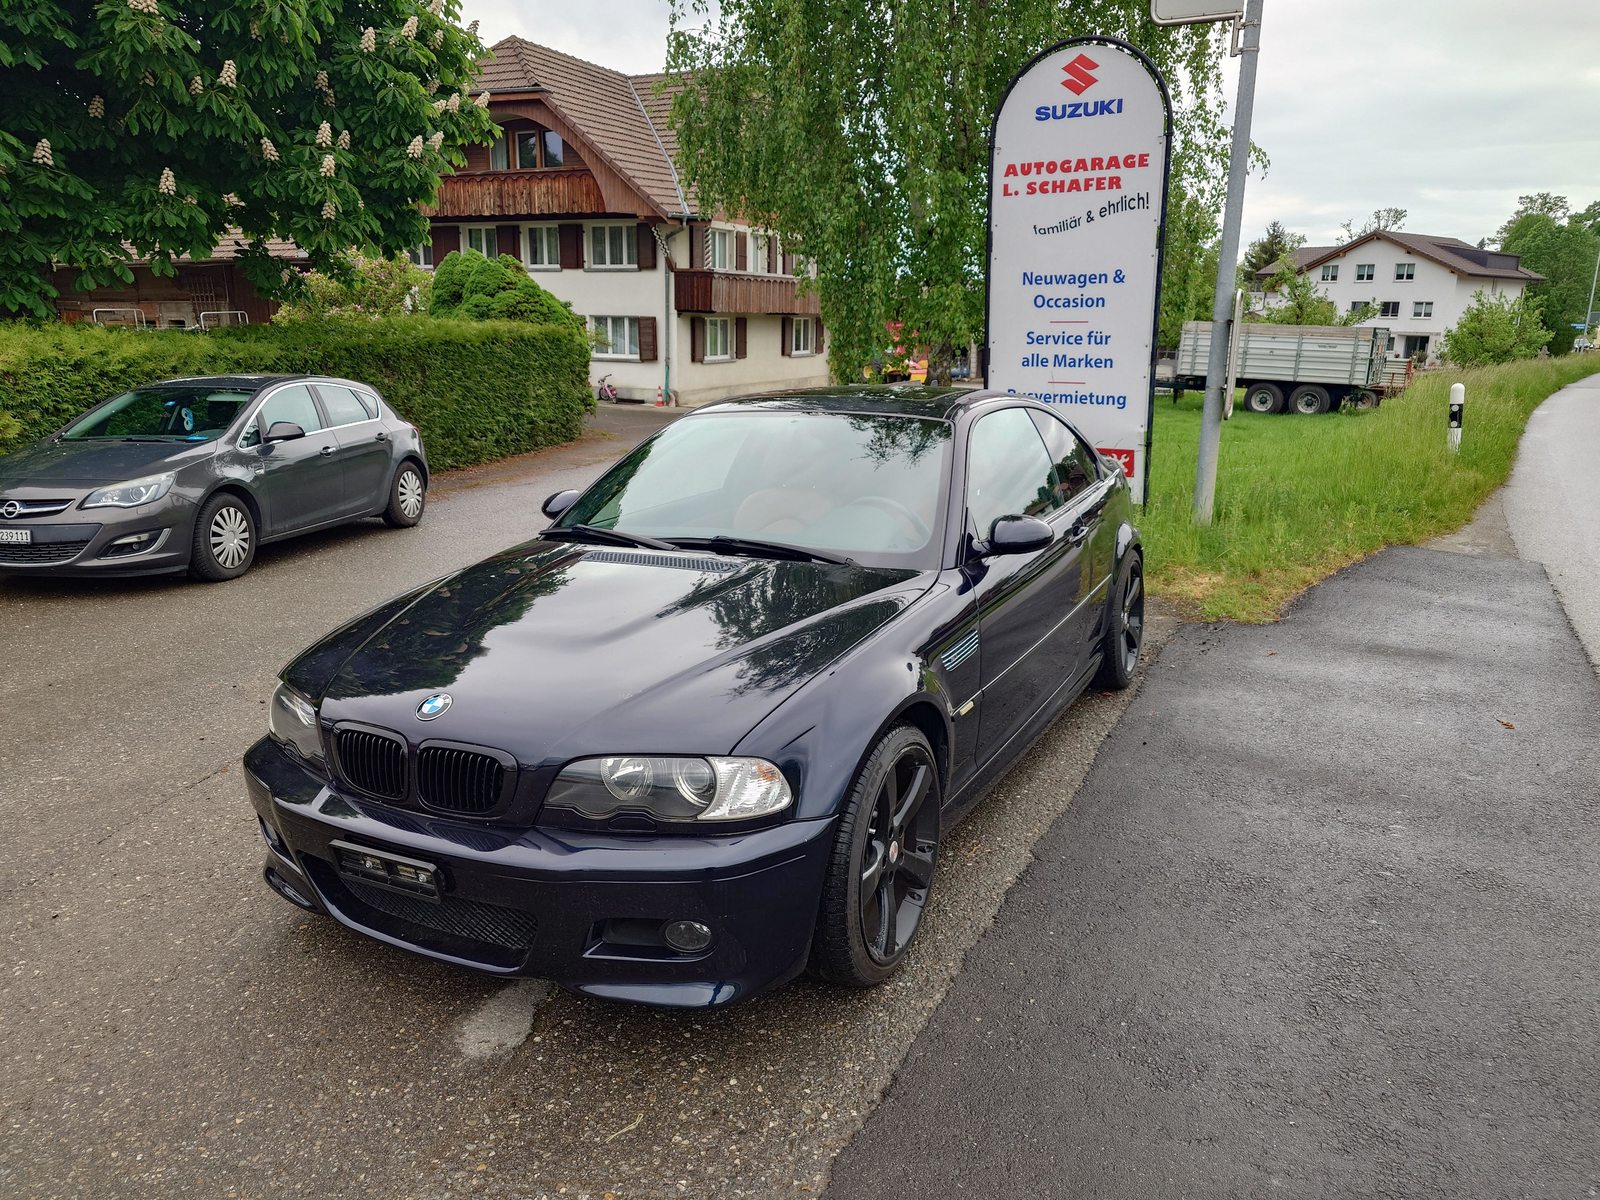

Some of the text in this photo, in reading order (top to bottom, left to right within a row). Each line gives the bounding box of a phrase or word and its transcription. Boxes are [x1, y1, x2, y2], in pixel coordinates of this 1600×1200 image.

[1035, 98, 1123, 121] SUZUKI
[1003, 153, 1150, 177] AUTOGARAGE
[1002, 175, 1122, 197] L. SCHAFER
[1033, 192, 1150, 235] familiär & ehrlich!
[1022, 269, 1126, 288] Neuwagen &
[1033, 293, 1106, 308] Occasion
[1026, 331, 1111, 345] Service für
[1021, 353, 1114, 368] alle Marken
[1008, 388, 1127, 409] vermietung
[0, 531, 29, 541] 239 111
